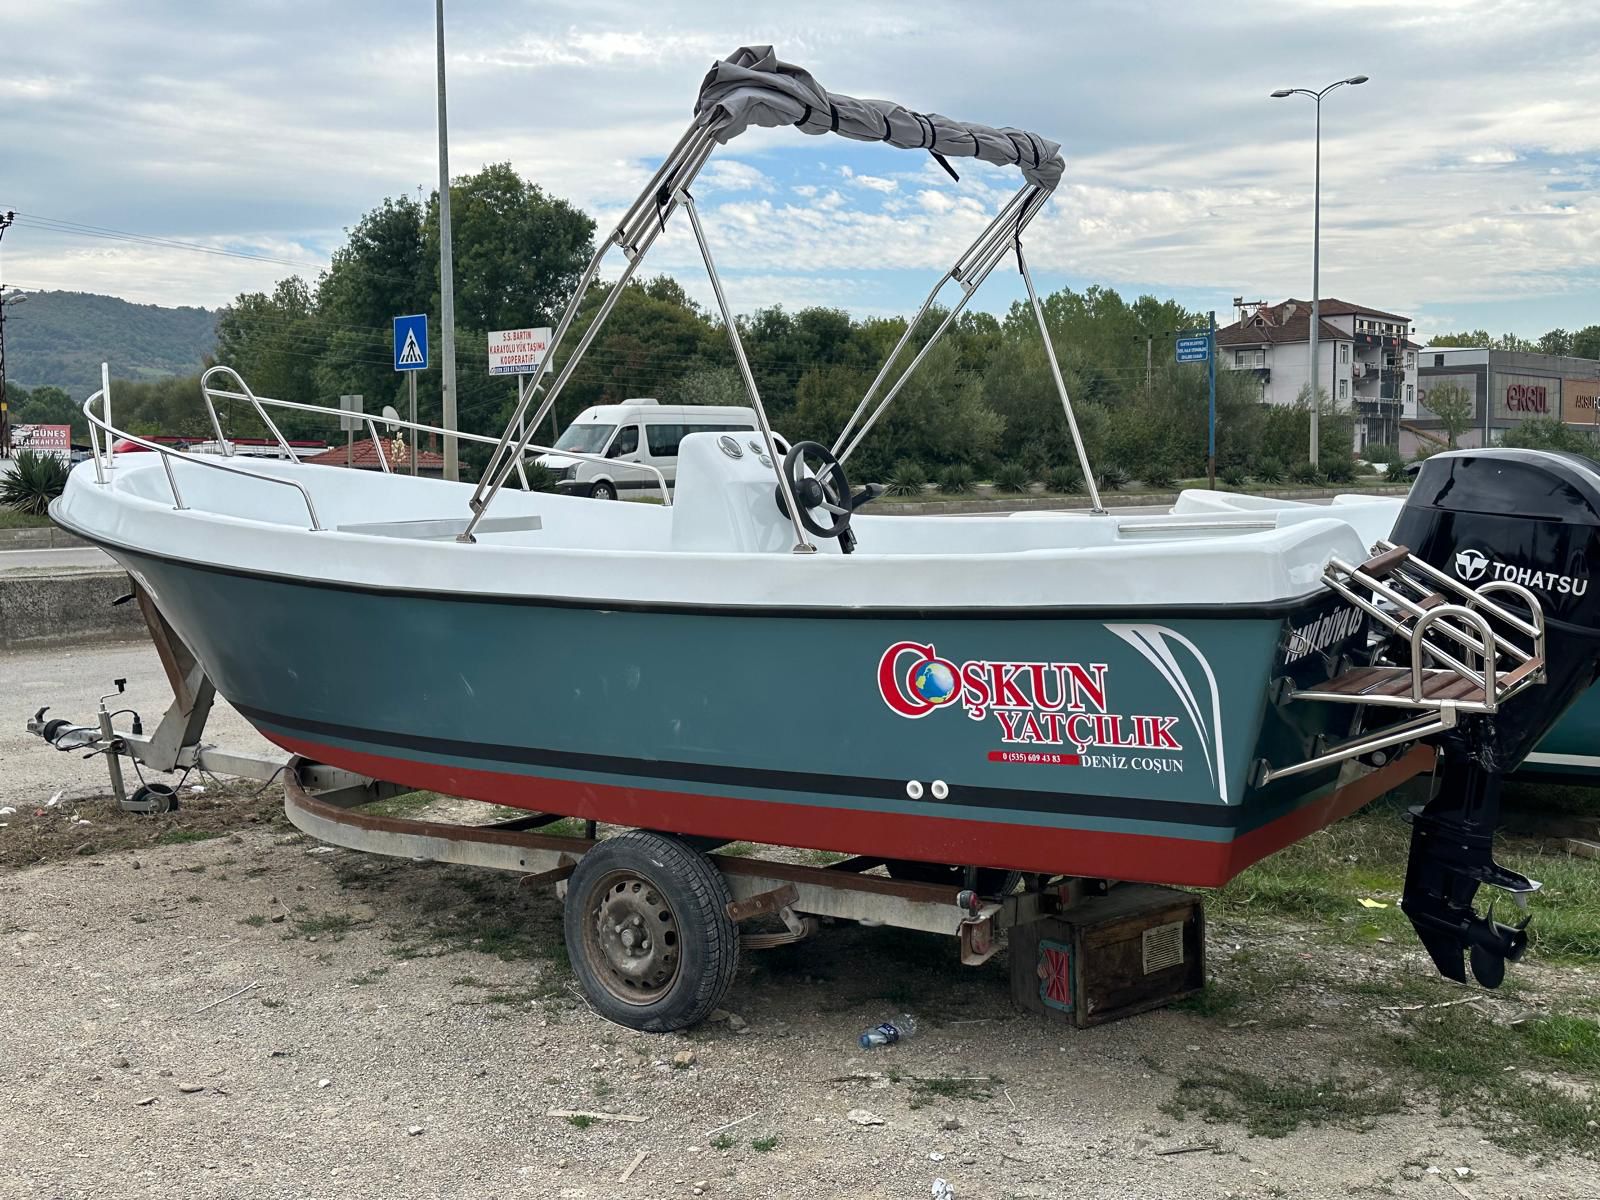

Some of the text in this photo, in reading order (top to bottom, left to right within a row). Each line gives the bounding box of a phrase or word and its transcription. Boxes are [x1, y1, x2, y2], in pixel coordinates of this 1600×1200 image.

[1492, 561, 1588, 596] TOHATSU
[1318, 606, 1351, 649] RÜYA
[877, 641, 1108, 721] COŞKUN
[994, 710, 1183, 753] YATÇILIK
[1009, 753, 1027, 762] (535)
[1028, 754, 1041, 762] 609
[1042, 755, 1051, 763] 43
[1081, 755, 1184, 773] DENİZ COŞUN
